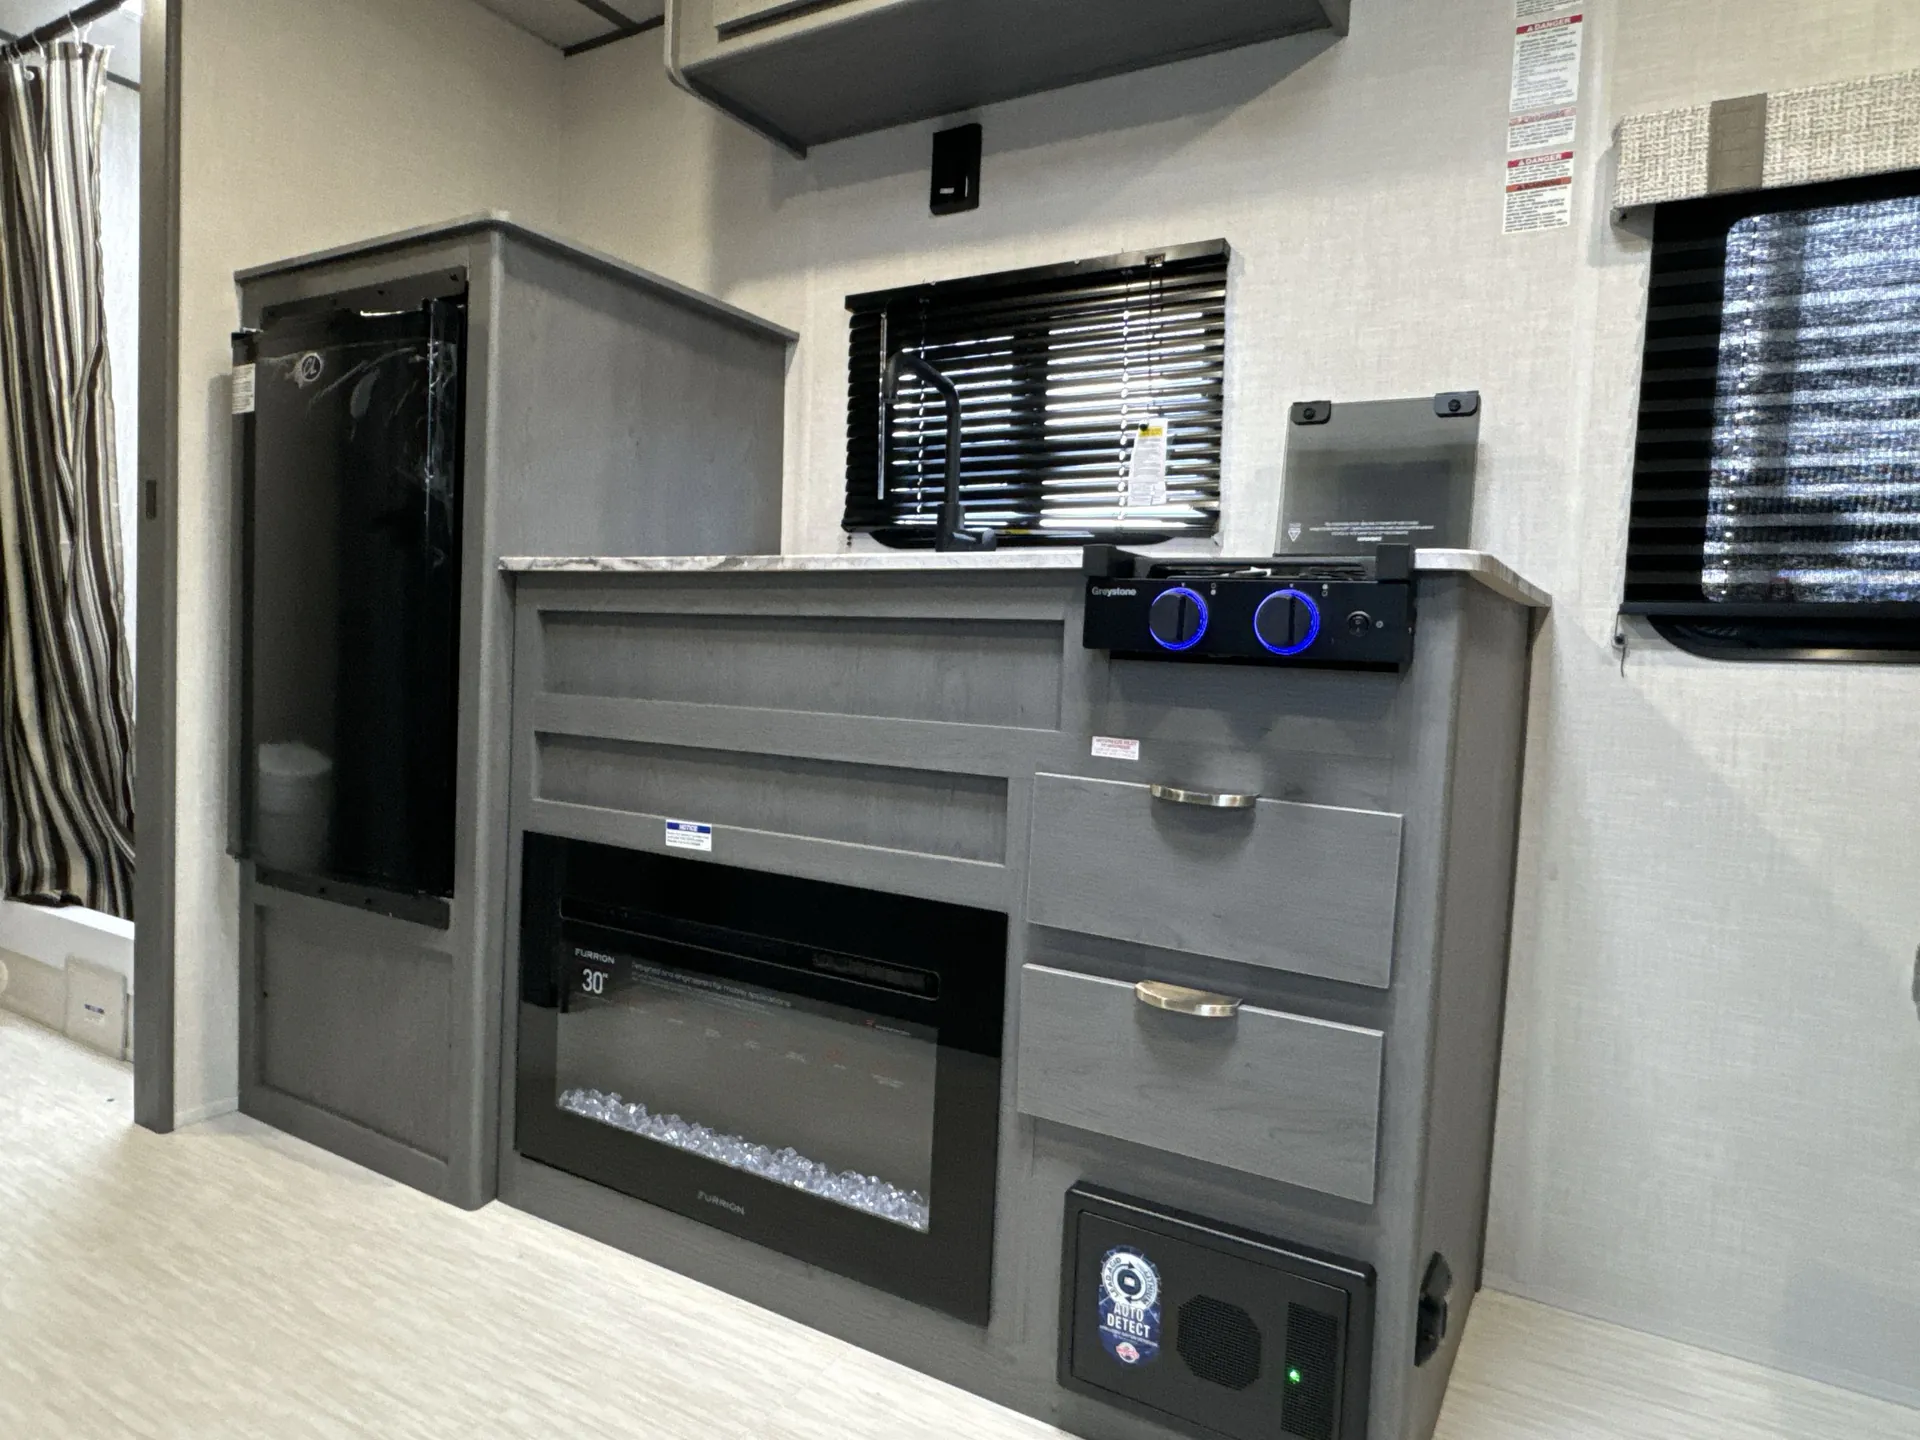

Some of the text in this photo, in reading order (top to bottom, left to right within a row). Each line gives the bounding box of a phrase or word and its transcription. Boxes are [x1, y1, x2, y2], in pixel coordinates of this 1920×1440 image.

[1534, 17, 1571, 31] DANGER
[1526, 154, 1562, 165] DANGER
[1091, 586, 1137, 597] Greystone
[575, 948, 615, 964] FURRION
[697, 1190, 745, 1216] FURRION
[1113, 1301, 1144, 1322] AUTO
[1107, 1312, 1151, 1338] DETECT
